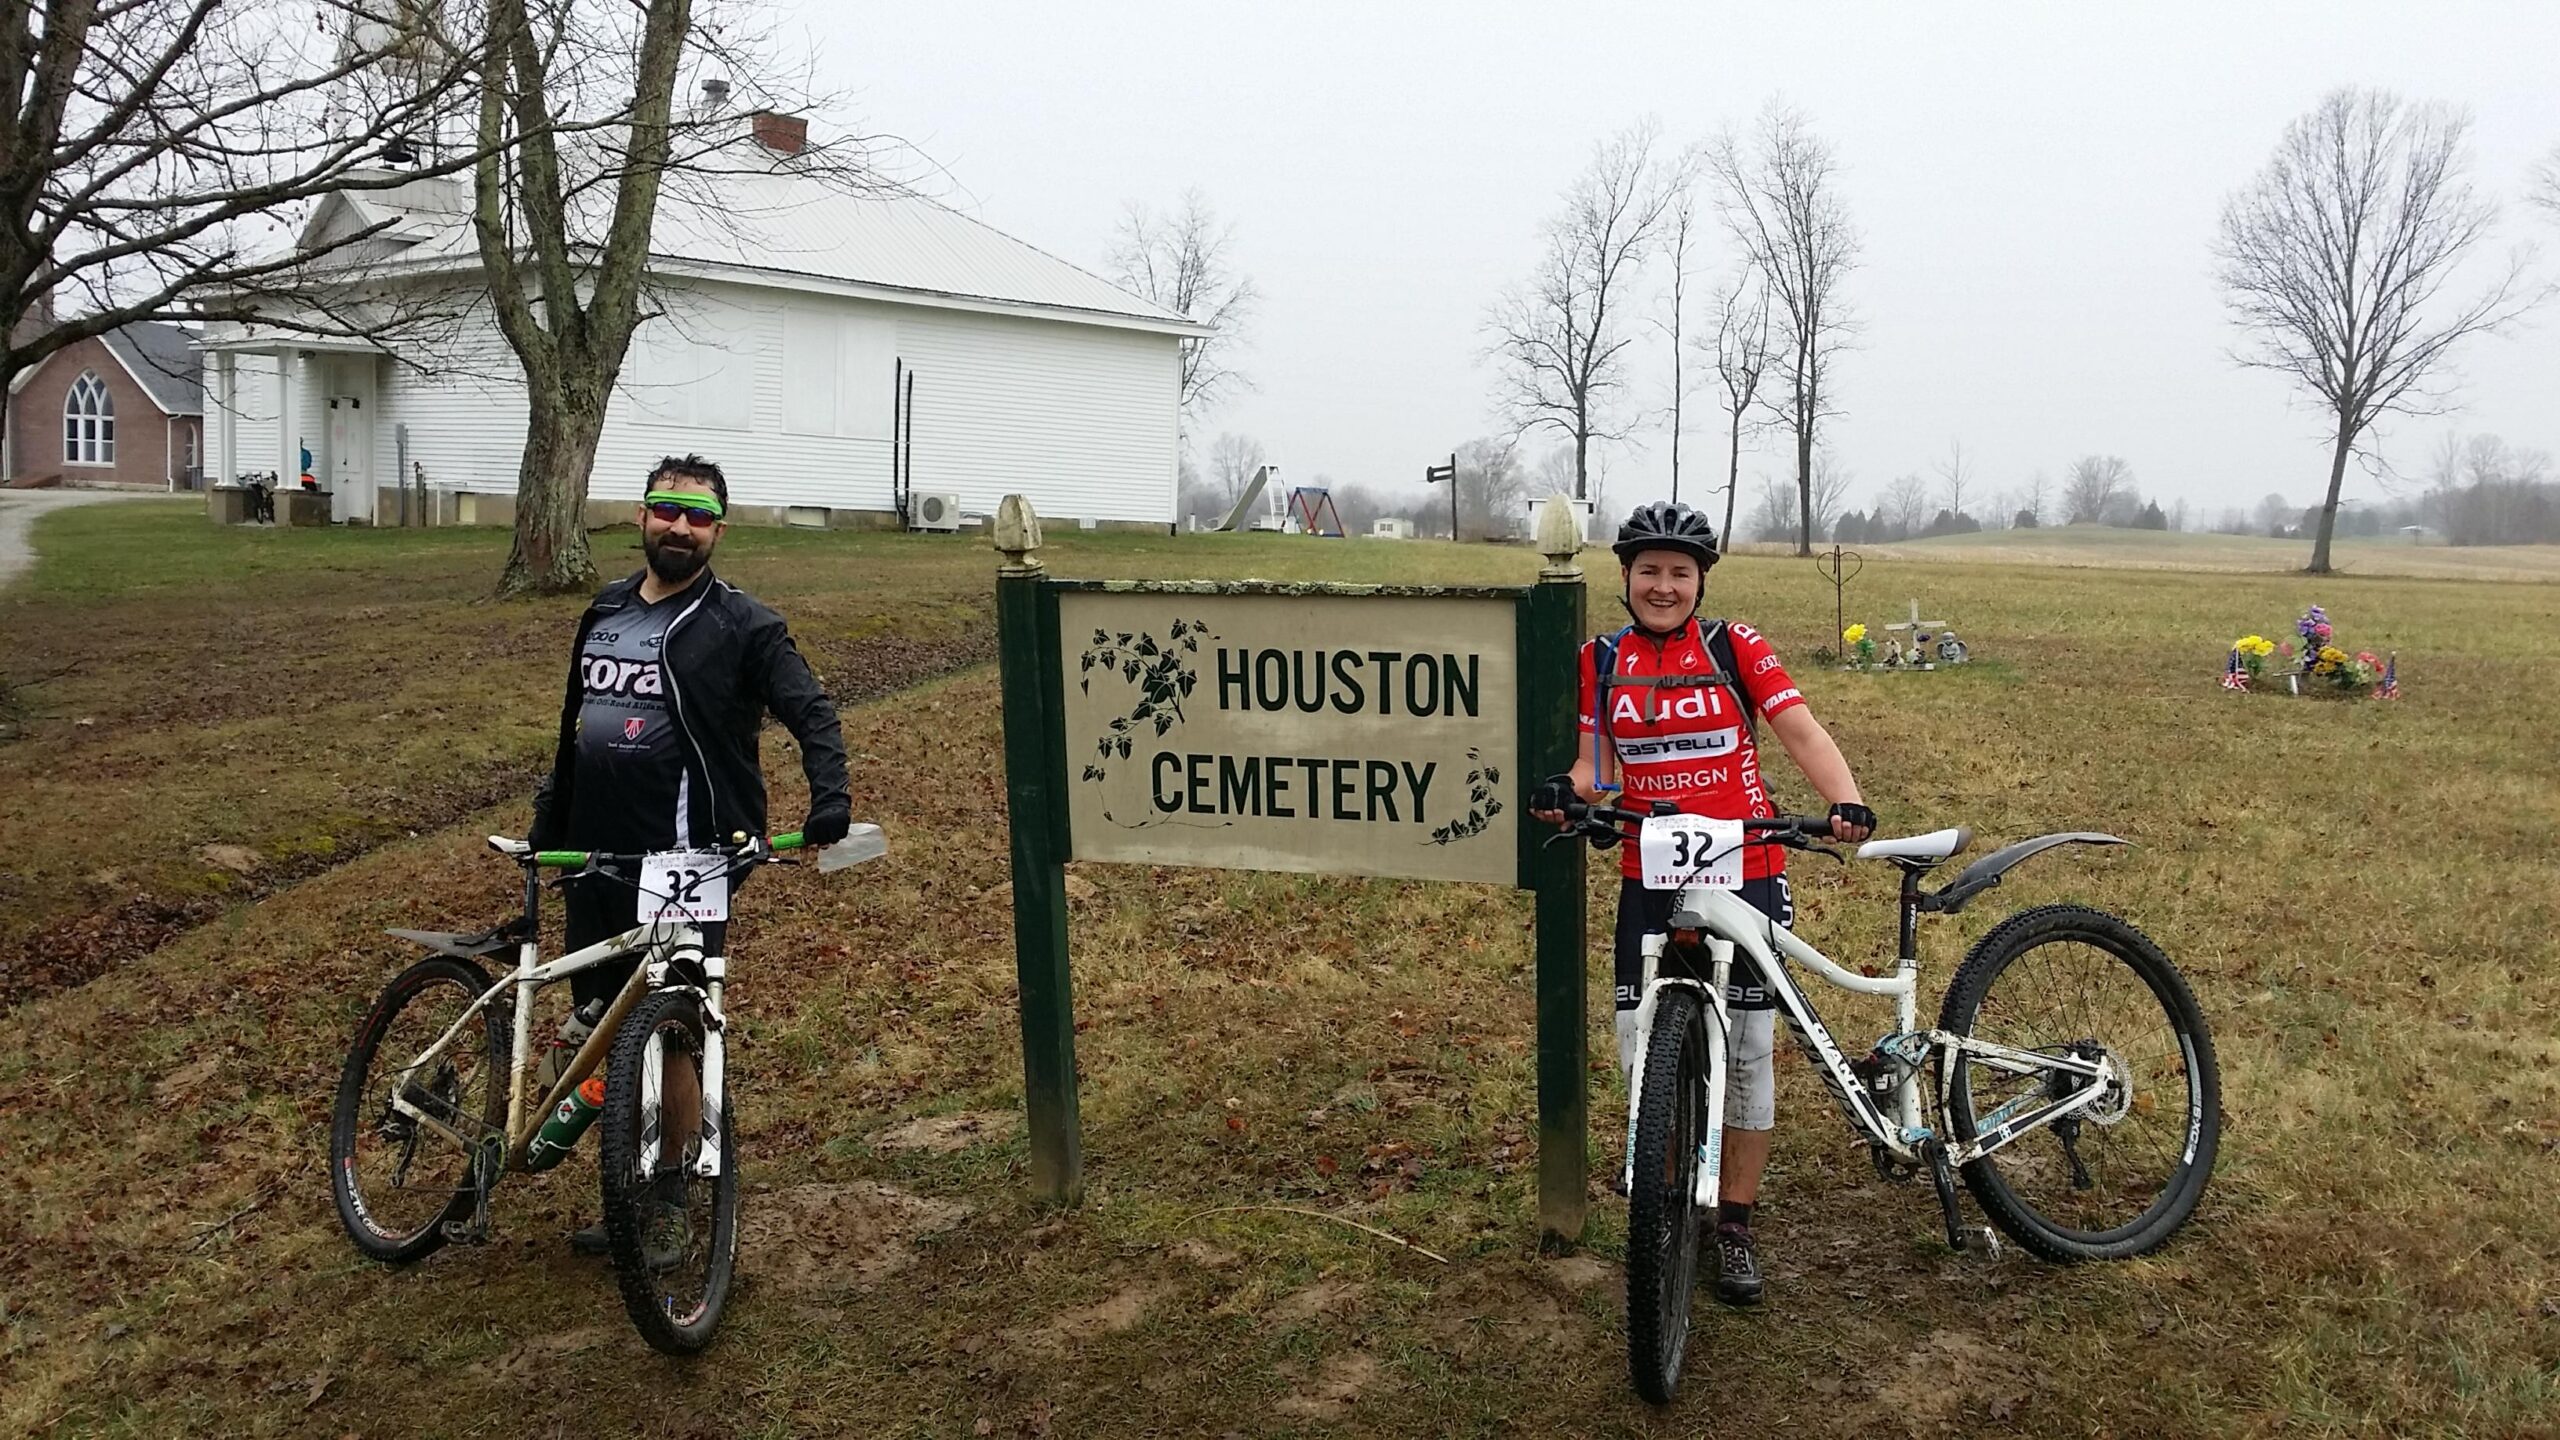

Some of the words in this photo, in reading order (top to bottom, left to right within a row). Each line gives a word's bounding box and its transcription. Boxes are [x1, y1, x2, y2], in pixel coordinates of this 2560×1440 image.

[1217, 648, 1479, 717] HOUSTON
[1152, 752, 1437, 823] CEMETERY
[1671, 831, 1713, 868] 32
[666, 869, 702, 903] 32
[1813, 1022, 1868, 1095] GIANT
[1708, 1127, 1721, 1177] ROCKSHOX
